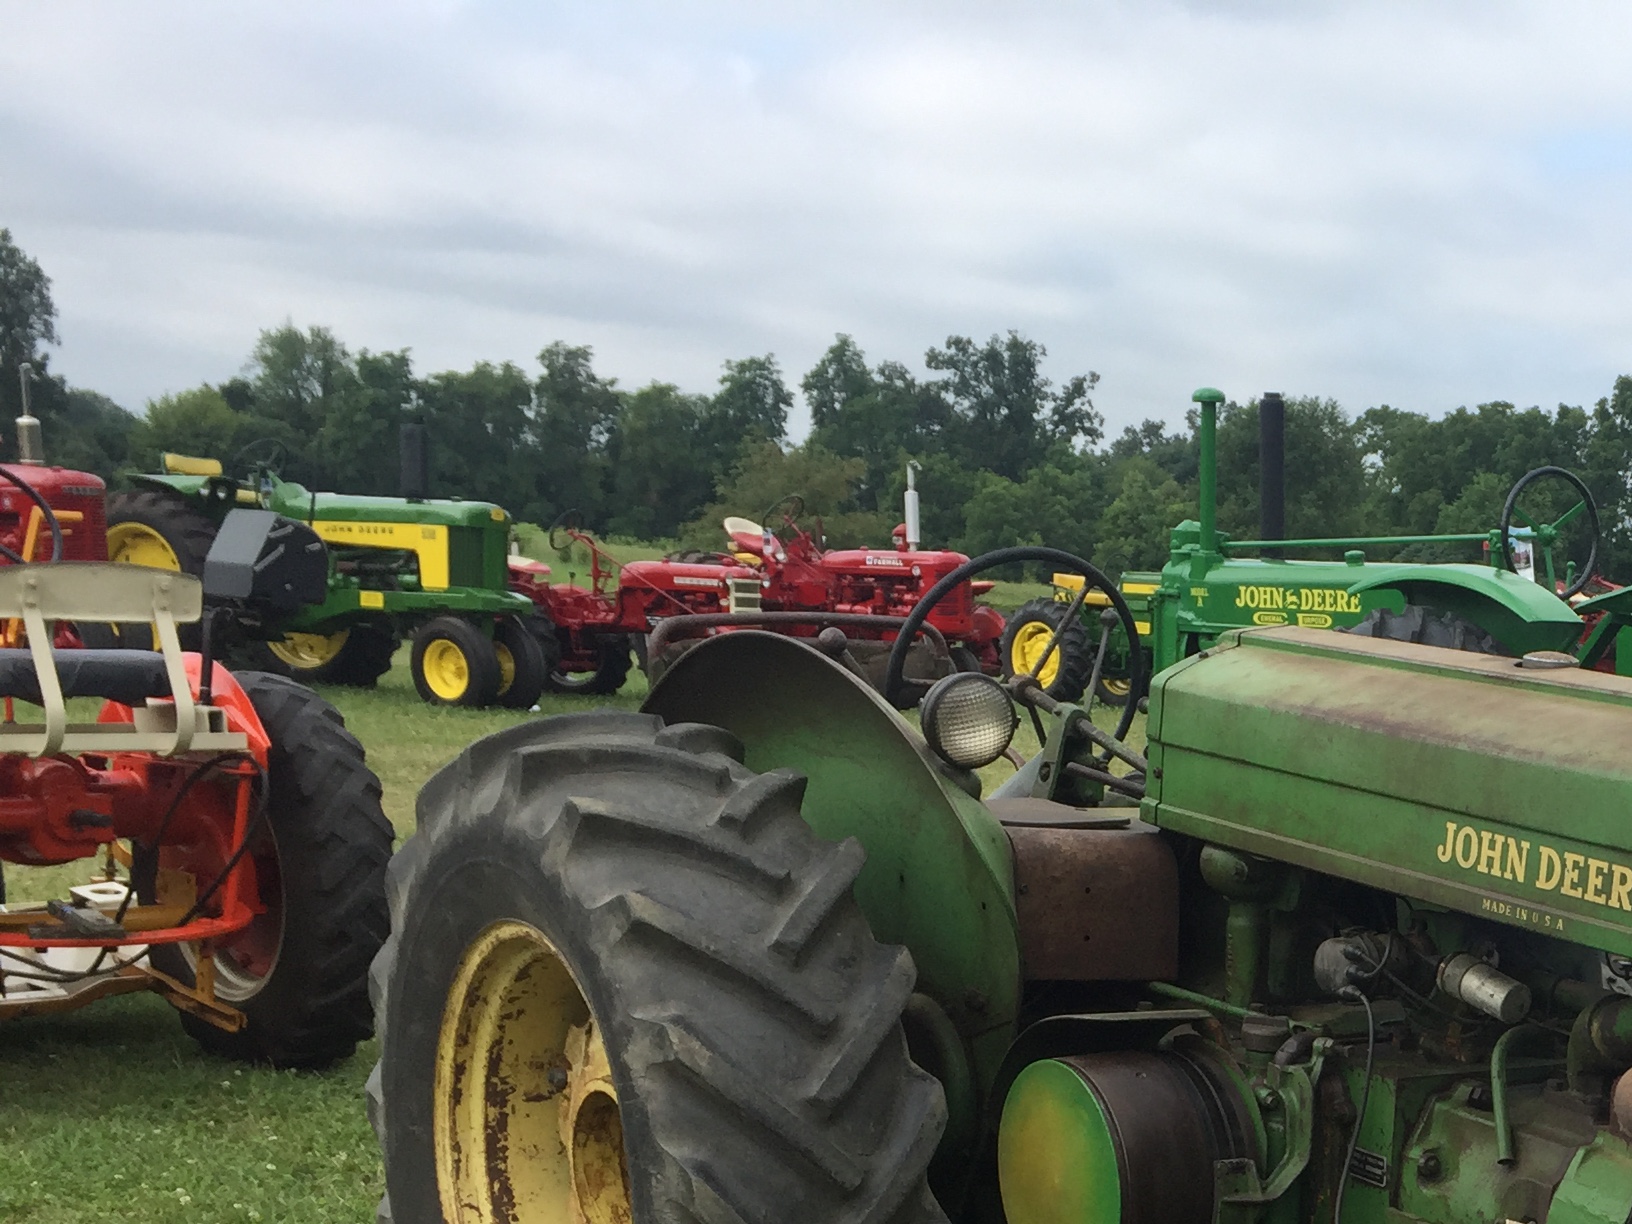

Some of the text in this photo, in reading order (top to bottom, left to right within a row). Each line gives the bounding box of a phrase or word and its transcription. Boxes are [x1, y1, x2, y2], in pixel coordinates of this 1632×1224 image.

[1235, 586, 1362, 613] JOHN DEERE
[1436, 821, 1530, 883] JOHN
[1482, 898, 1511, 917] MADE
[1515, 907, 1527, 921] IN
